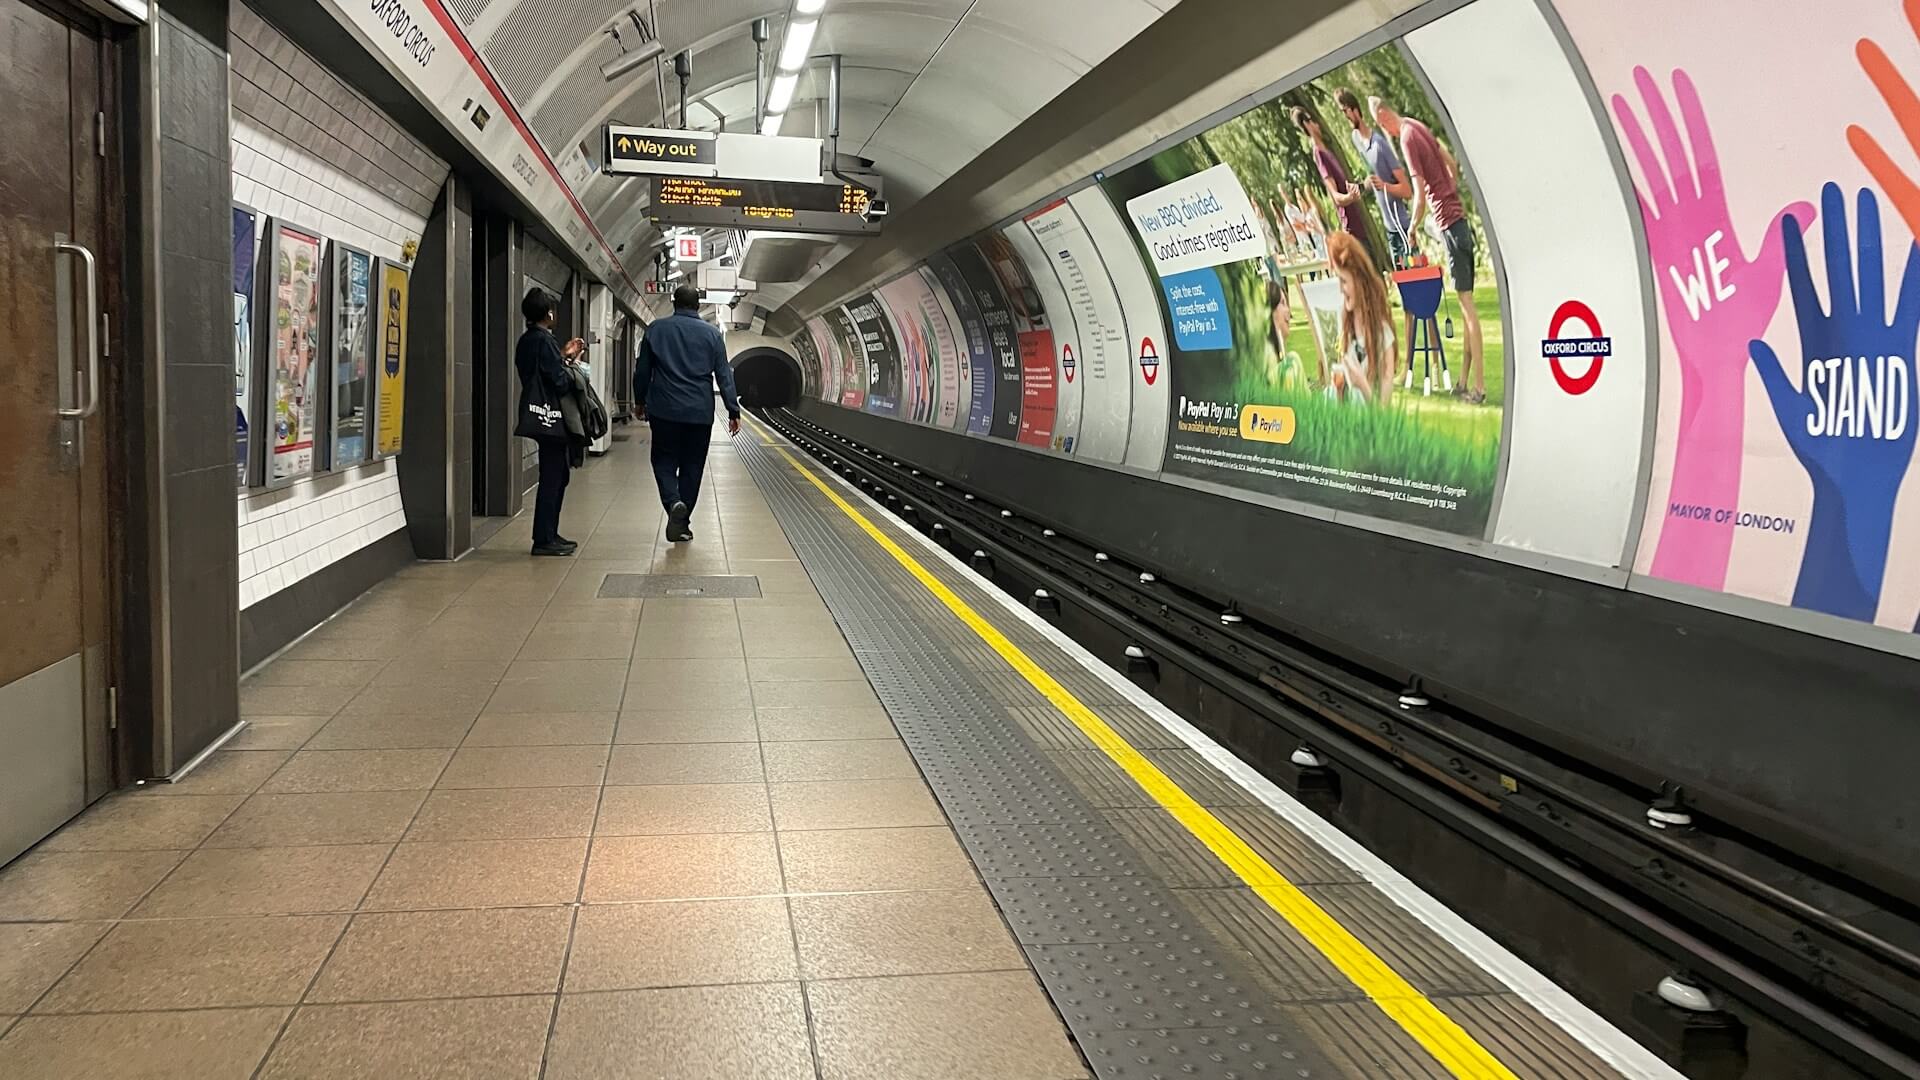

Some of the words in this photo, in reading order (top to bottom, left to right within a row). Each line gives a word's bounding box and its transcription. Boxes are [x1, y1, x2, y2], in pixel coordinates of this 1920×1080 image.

[404, 25, 435, 67] CIRCUS
[633, 139, 666, 157] Way
[669, 144, 697, 156] out
[1138, 213, 1162, 233] New
[1158, 203, 1187, 228] BBQ
[1154, 234, 1180, 260] Good
[1178, 234, 1206, 256] times
[1205, 214, 1256, 252] reignited.
[1669, 230, 1737, 321] WE
[1544, 343, 1577, 354] OXFORD
[1578, 341, 1609, 353] CIRCUS
[1187, 401, 1210, 420] PayPal
[1210, 403, 1224, 423] Pay
[1224, 402, 1232, 418] in
[1232, 404, 1238, 419] 3
[1806, 355, 1910, 440] STAND
[1260, 418, 1282, 433] PayPal
[1669, 503, 1711, 520] MAYOR
[1715, 509, 1732, 523] OF
[1735, 512, 1795, 534] LONDON
